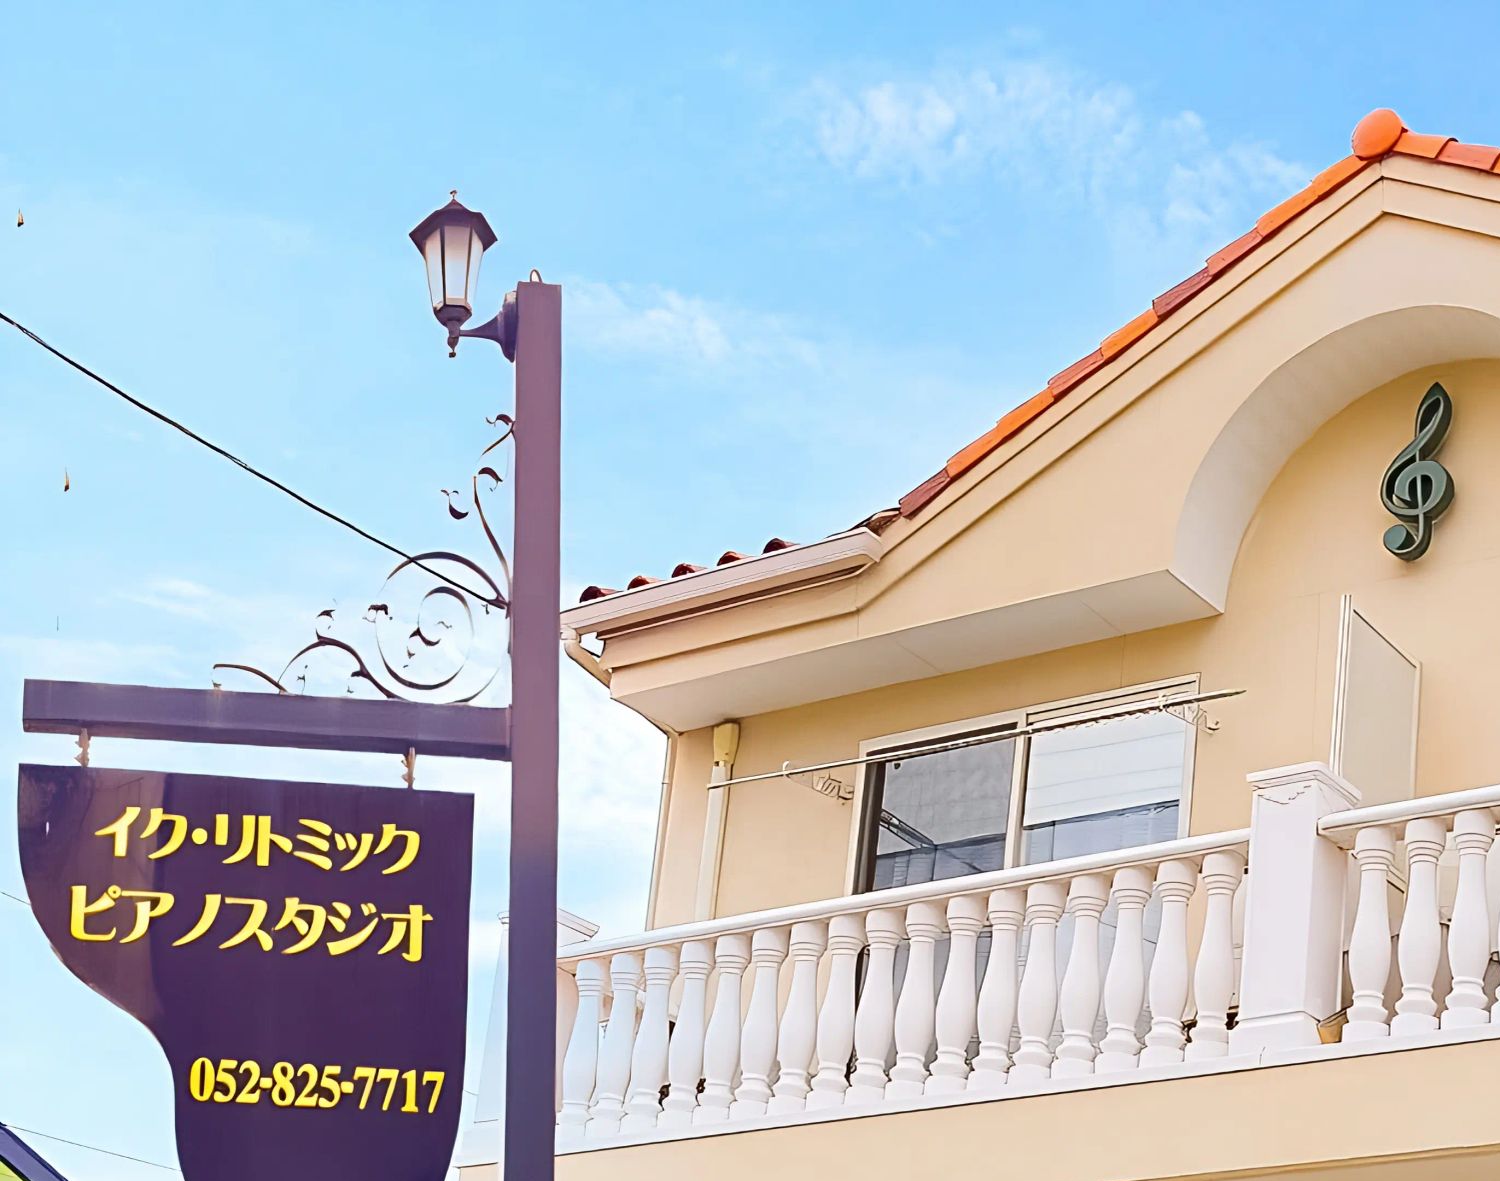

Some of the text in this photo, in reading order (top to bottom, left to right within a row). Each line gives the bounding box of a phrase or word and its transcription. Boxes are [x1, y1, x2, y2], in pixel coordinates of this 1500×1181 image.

[95, 807, 421, 875] イク・リトミック
[70, 885, 433, 962] ピアノスタジオ
[189, 1057, 445, 1114] 052-825-7717
